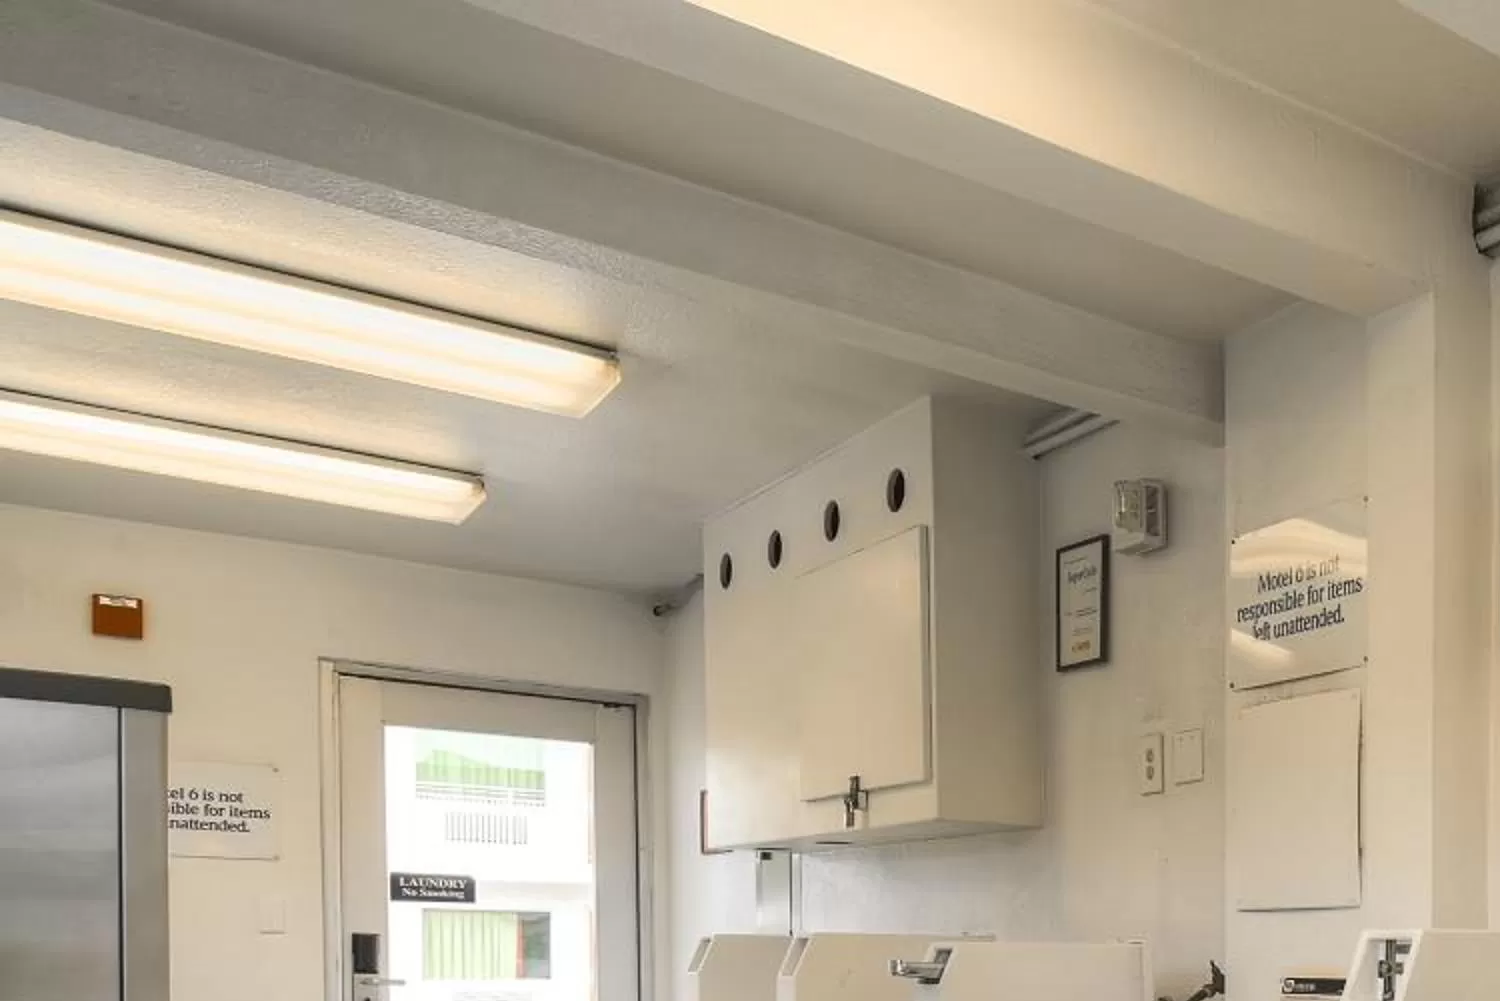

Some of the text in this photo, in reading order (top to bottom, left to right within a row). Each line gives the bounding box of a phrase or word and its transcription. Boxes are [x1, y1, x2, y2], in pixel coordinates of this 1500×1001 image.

[1257, 566, 1293, 594] Motel
[1306, 560, 1317, 582] is
[1319, 553, 1340, 577] not
[1237, 576, 1364, 626] responsible for items
[1273, 604, 1345, 639] unattended.
[167, 787, 244, 803] el 6 is not
[168, 802, 271, 819] ible for items
[399, 876, 467, 889] LAUNDRY
[401, 888, 418, 897] No
